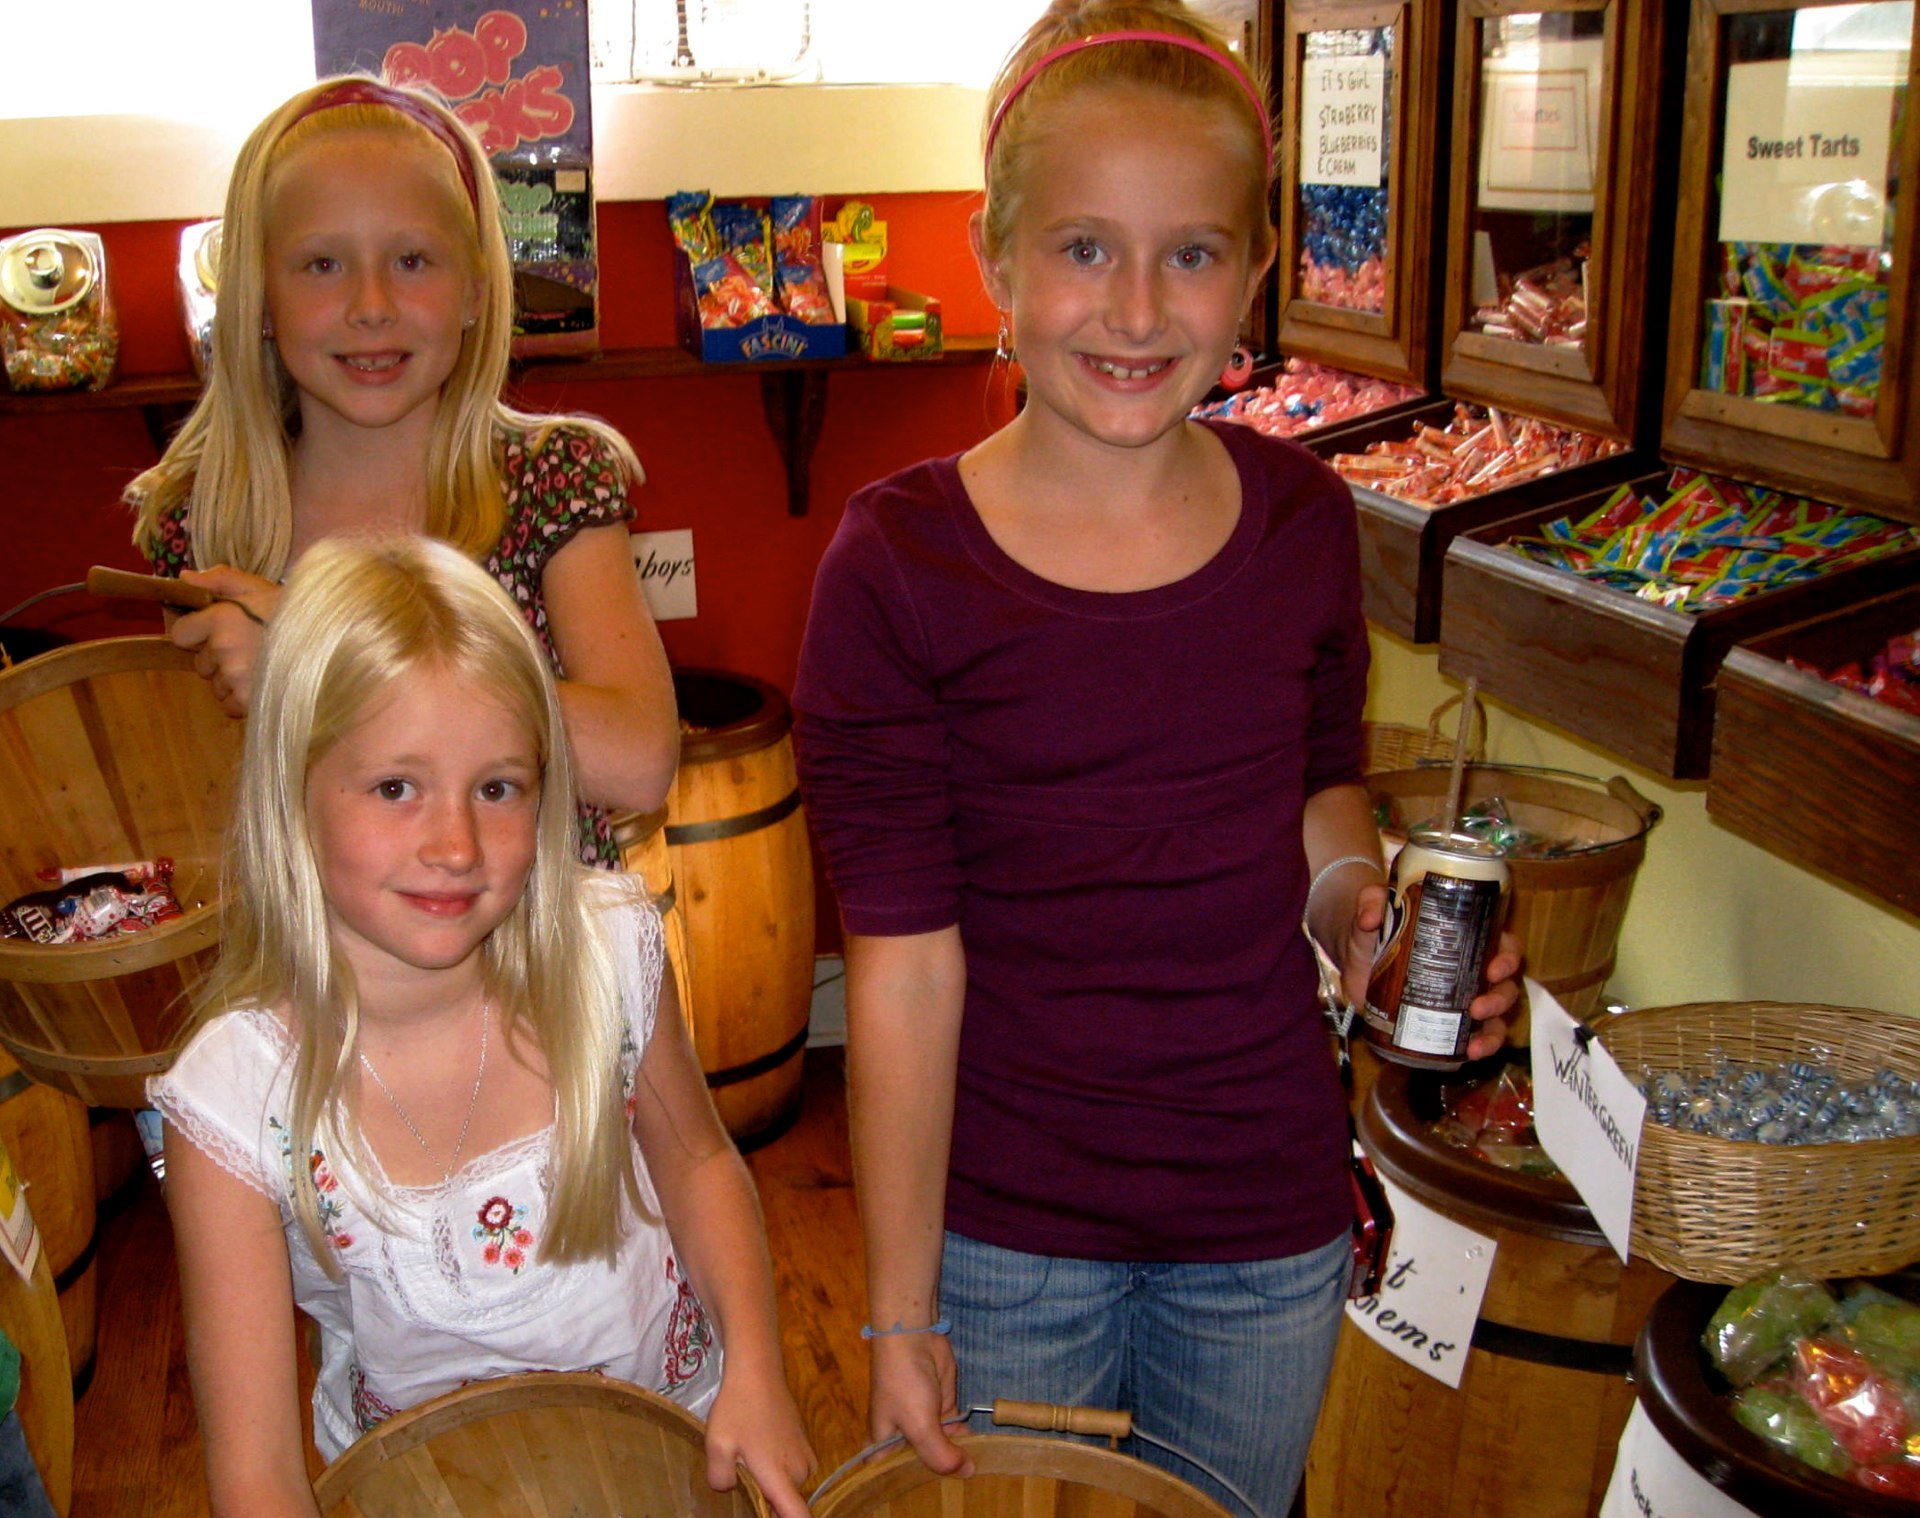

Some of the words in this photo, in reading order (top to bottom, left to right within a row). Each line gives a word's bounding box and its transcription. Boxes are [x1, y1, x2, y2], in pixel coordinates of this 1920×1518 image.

[382, 10, 528, 99] POP
[1747, 135, 1803, 160] Sweet
[1810, 133, 1860, 158] Tarts
[1550, 1043, 1634, 1172] WINTERGREEN
